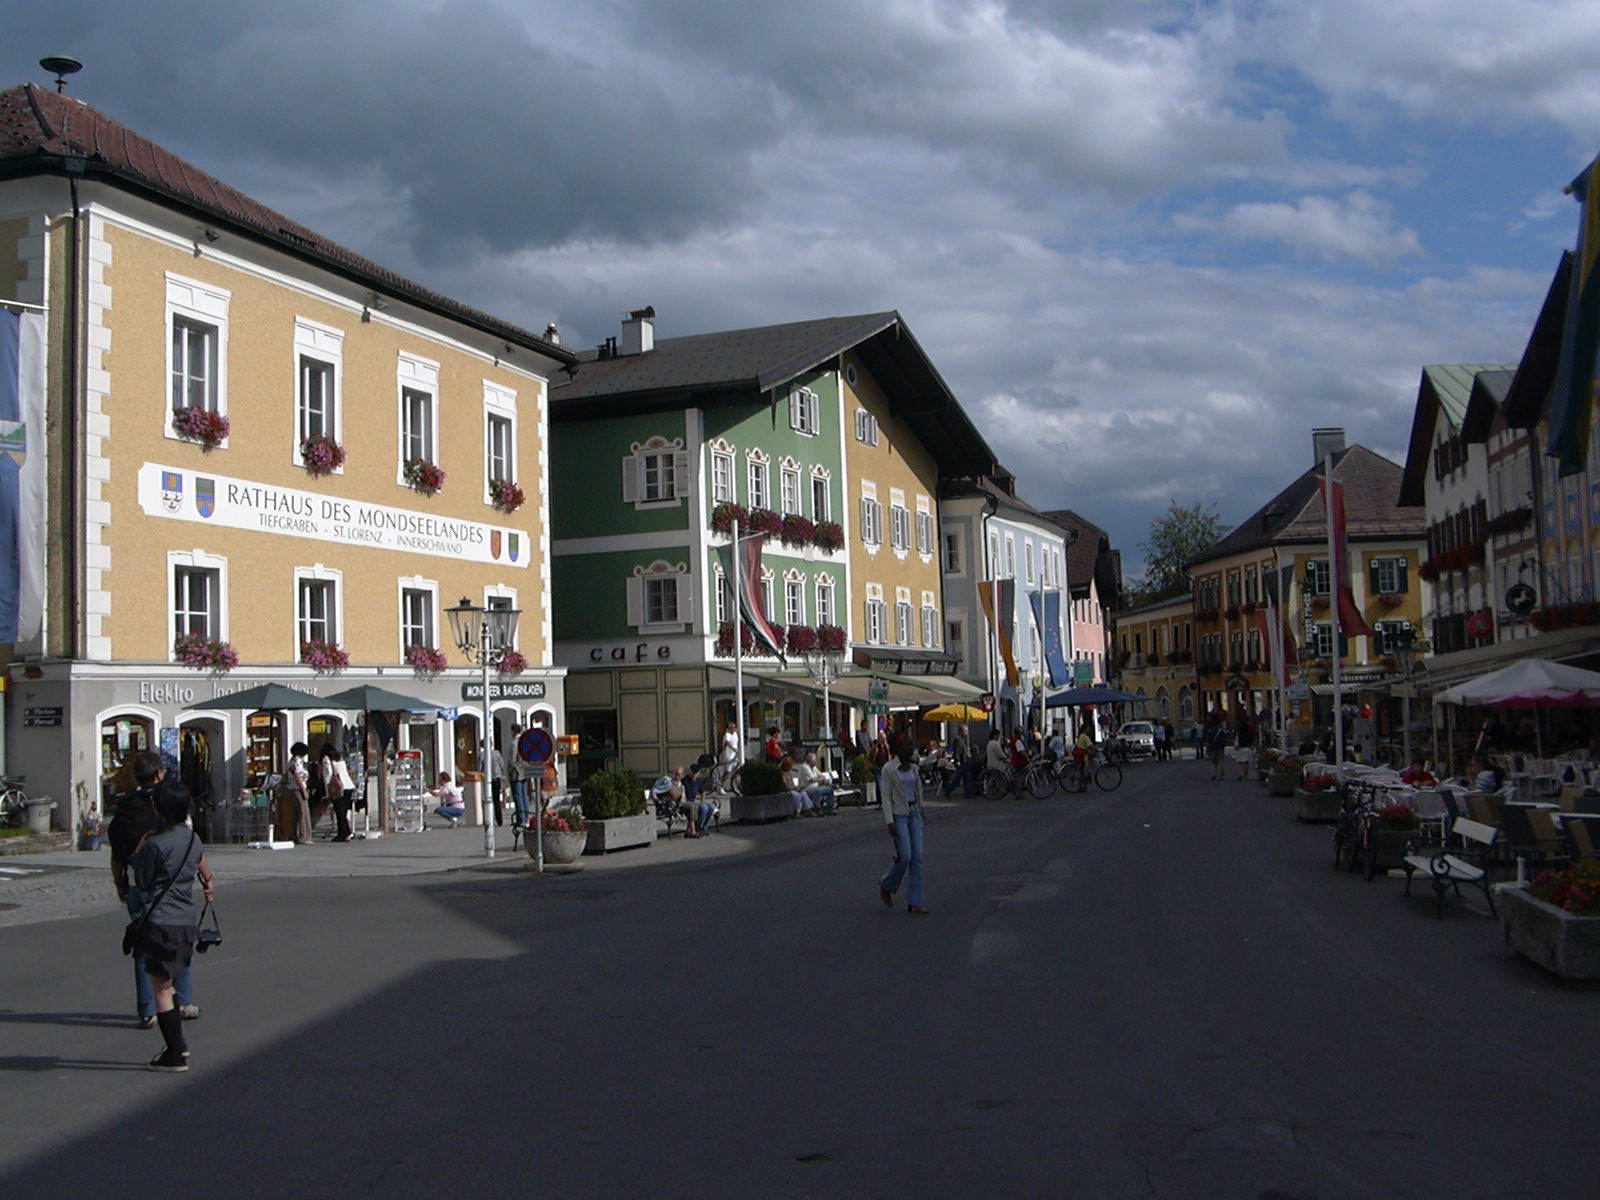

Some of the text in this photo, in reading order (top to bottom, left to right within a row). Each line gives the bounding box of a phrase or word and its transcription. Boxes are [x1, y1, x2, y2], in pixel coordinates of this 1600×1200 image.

[228, 484, 484, 544] RATHAUS DES MONDSEELANDES
[259, 512, 319, 534] TIEFGRABEN
[396, 534, 463, 554] INNERSCHWAND
[590, 643, 671, 663] cafe
[139, 681, 195, 704] Elektro
[466, 685, 501, 698] MONEER
